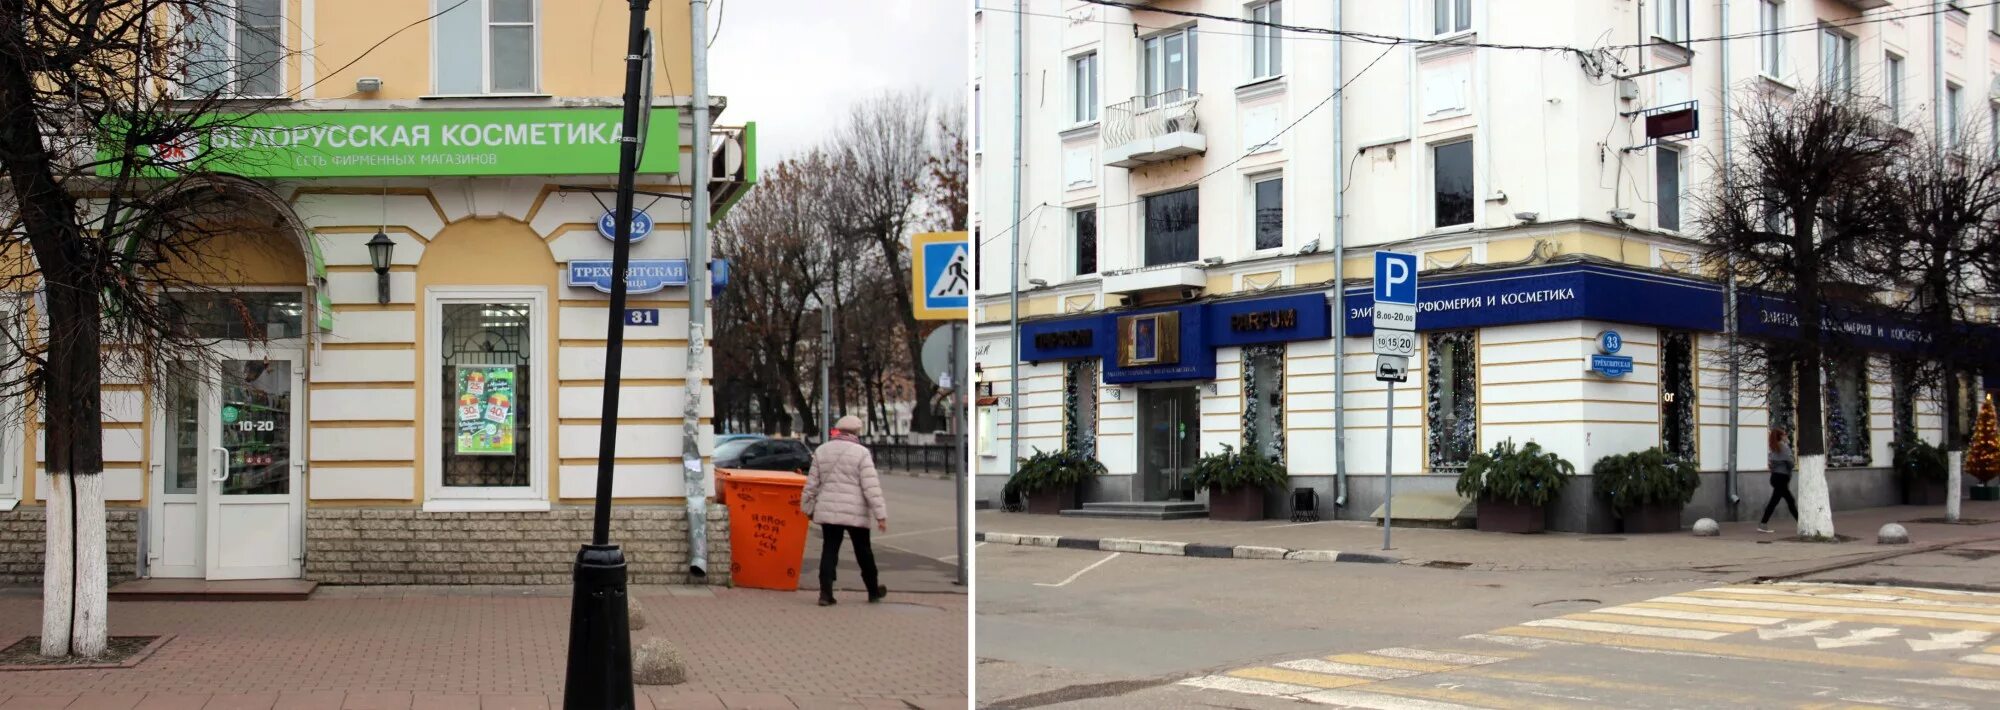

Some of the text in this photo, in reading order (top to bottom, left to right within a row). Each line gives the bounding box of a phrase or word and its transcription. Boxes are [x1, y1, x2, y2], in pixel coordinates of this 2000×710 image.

[210, 122, 624, 149] БЕЛОРУССКАЯ КОСМЕТИКА
[296, 152, 497, 167] СЕТЬ ФИРМЕННЫХ МАГАЗИНОВ
[574, 267, 683, 278] ТРЕХЯТСКАЯ
[1385, 257, 1409, 297] P
[1414, 296, 1482, 314] РФЮМЕРИЯ
[1486, 296, 1496, 306] И
[1500, 288, 1575, 306] КОСМЕТИКА
[631, 310, 653, 323] 31
[1378, 338, 1411, 349] 10 15 20
[1606, 336, 1618, 349] 33
